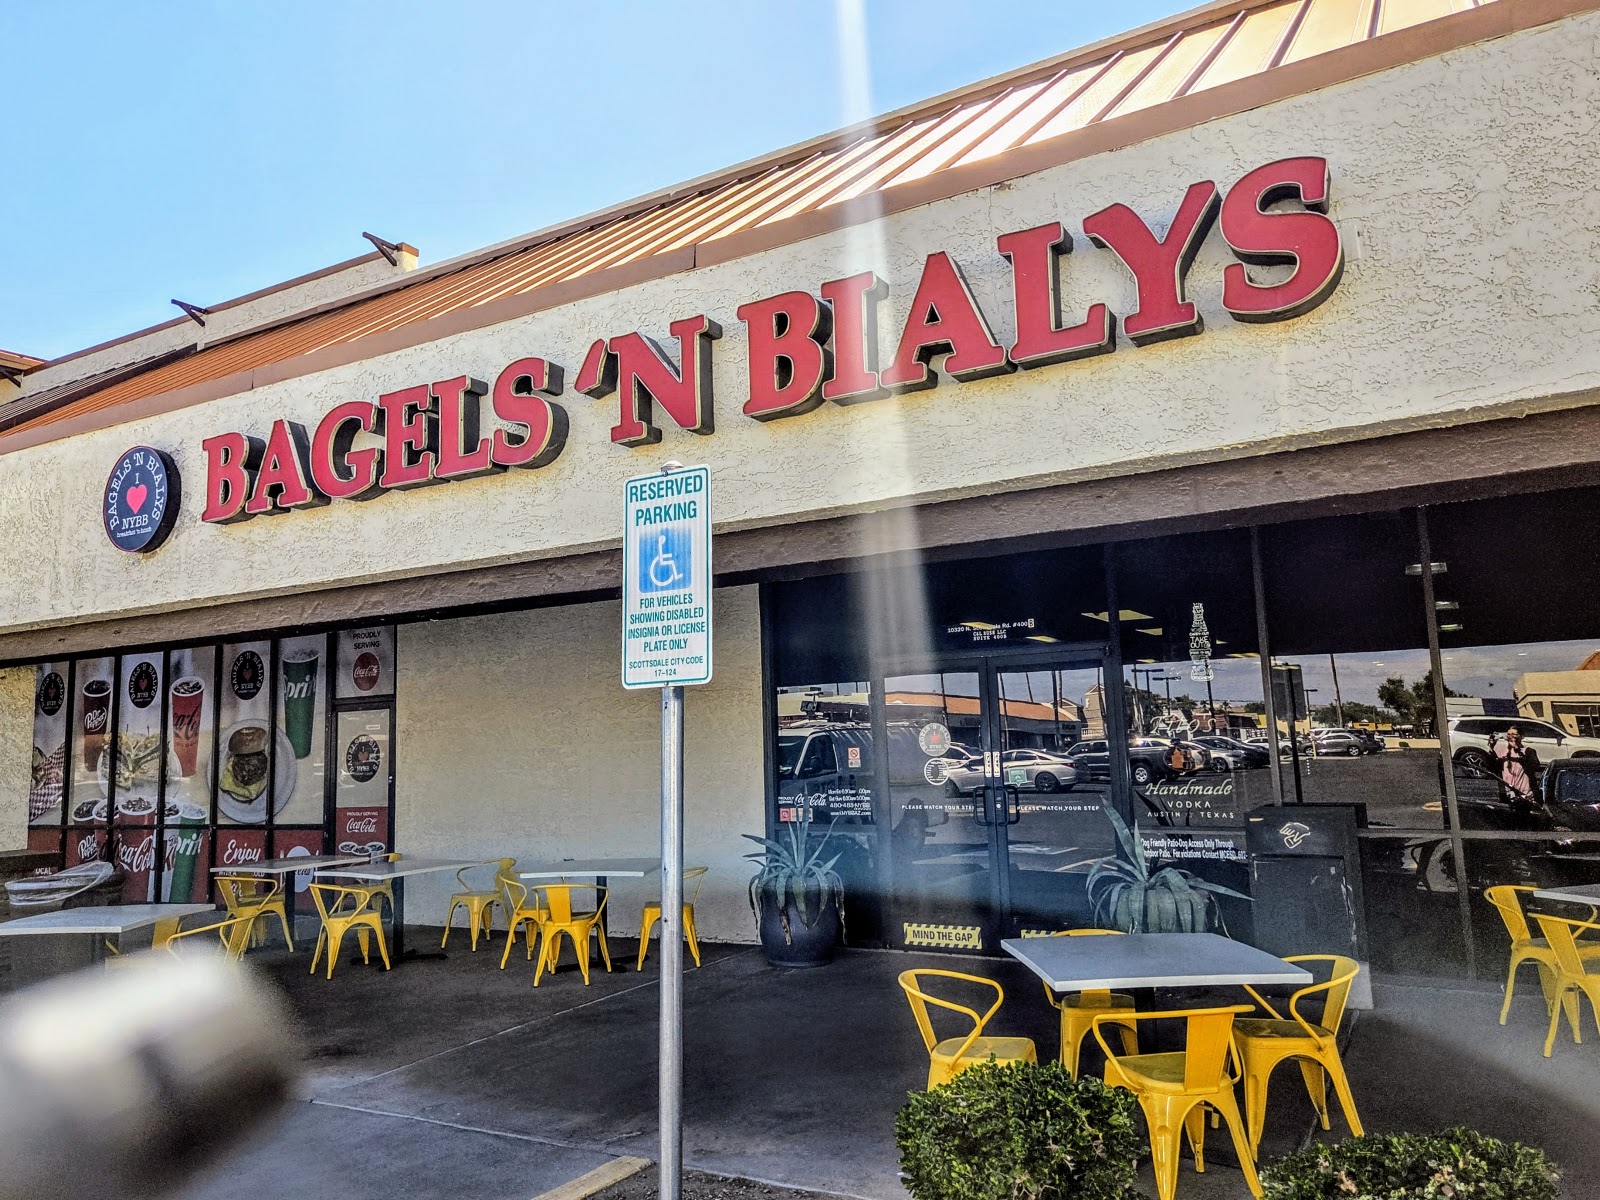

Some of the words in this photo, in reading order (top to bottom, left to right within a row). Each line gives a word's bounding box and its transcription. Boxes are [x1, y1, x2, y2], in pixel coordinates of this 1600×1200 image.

[202, 357, 566, 524] BAGELS
[576, 316, 722, 446] 'N
[737, 157, 1343, 421] BIALYS
[135, 473, 140, 484] I
[108, 459, 132, 530] BAGELS
[133, 452, 144, 466] 'N
[146, 456, 164, 520] BIALYS
[629, 474, 703, 503] RESERVED
[635, 501, 697, 526] PARKING
[122, 514, 149, 530] NYBB
[640, 597, 655, 609] FOR
[657, 593, 693, 607] VEHICLES
[630, 611, 665, 625] SHOWING
[667, 606, 704, 621] DISABLED
[353, 630, 381, 640] PROUDLY
[628, 625, 660, 640] INSIGNIA
[662, 627, 673, 637] OR
[674, 621, 706, 635] LICENSE
[354, 641, 380, 650] SERVING
[643, 640, 669, 652] PLATE
[669, 637, 688, 650] ONLY
[629, 659, 669, 669] SCOTTSDALE
[671, 658, 684, 666] CITY
[686, 656, 704, 665] CODE
[654, 668, 677, 677] 17-124
[92, 709, 101, 719] Dr
[1145, 778, 1233, 795] Handmade
[1167, 801, 1211, 809] VODKA
[1200, 811, 1234, 819] TEXAS
[346, 817, 377, 833] Coca-Cola
[1150, 838, 1166, 849] Friendly
[1189, 838, 1204, 847] Access
[1204, 838, 1215, 849] Only
[1215, 838, 1234, 850] Through
[223, 839, 261, 865] Enjoy
[1143, 849, 1158, 857] utdoor
[1181, 849, 1201, 858] violations
[1202, 850, 1219, 859] Contact
[912, 929, 935, 941] MIND
[936, 930, 953, 941] THE
[954, 931, 973, 943] GAP
